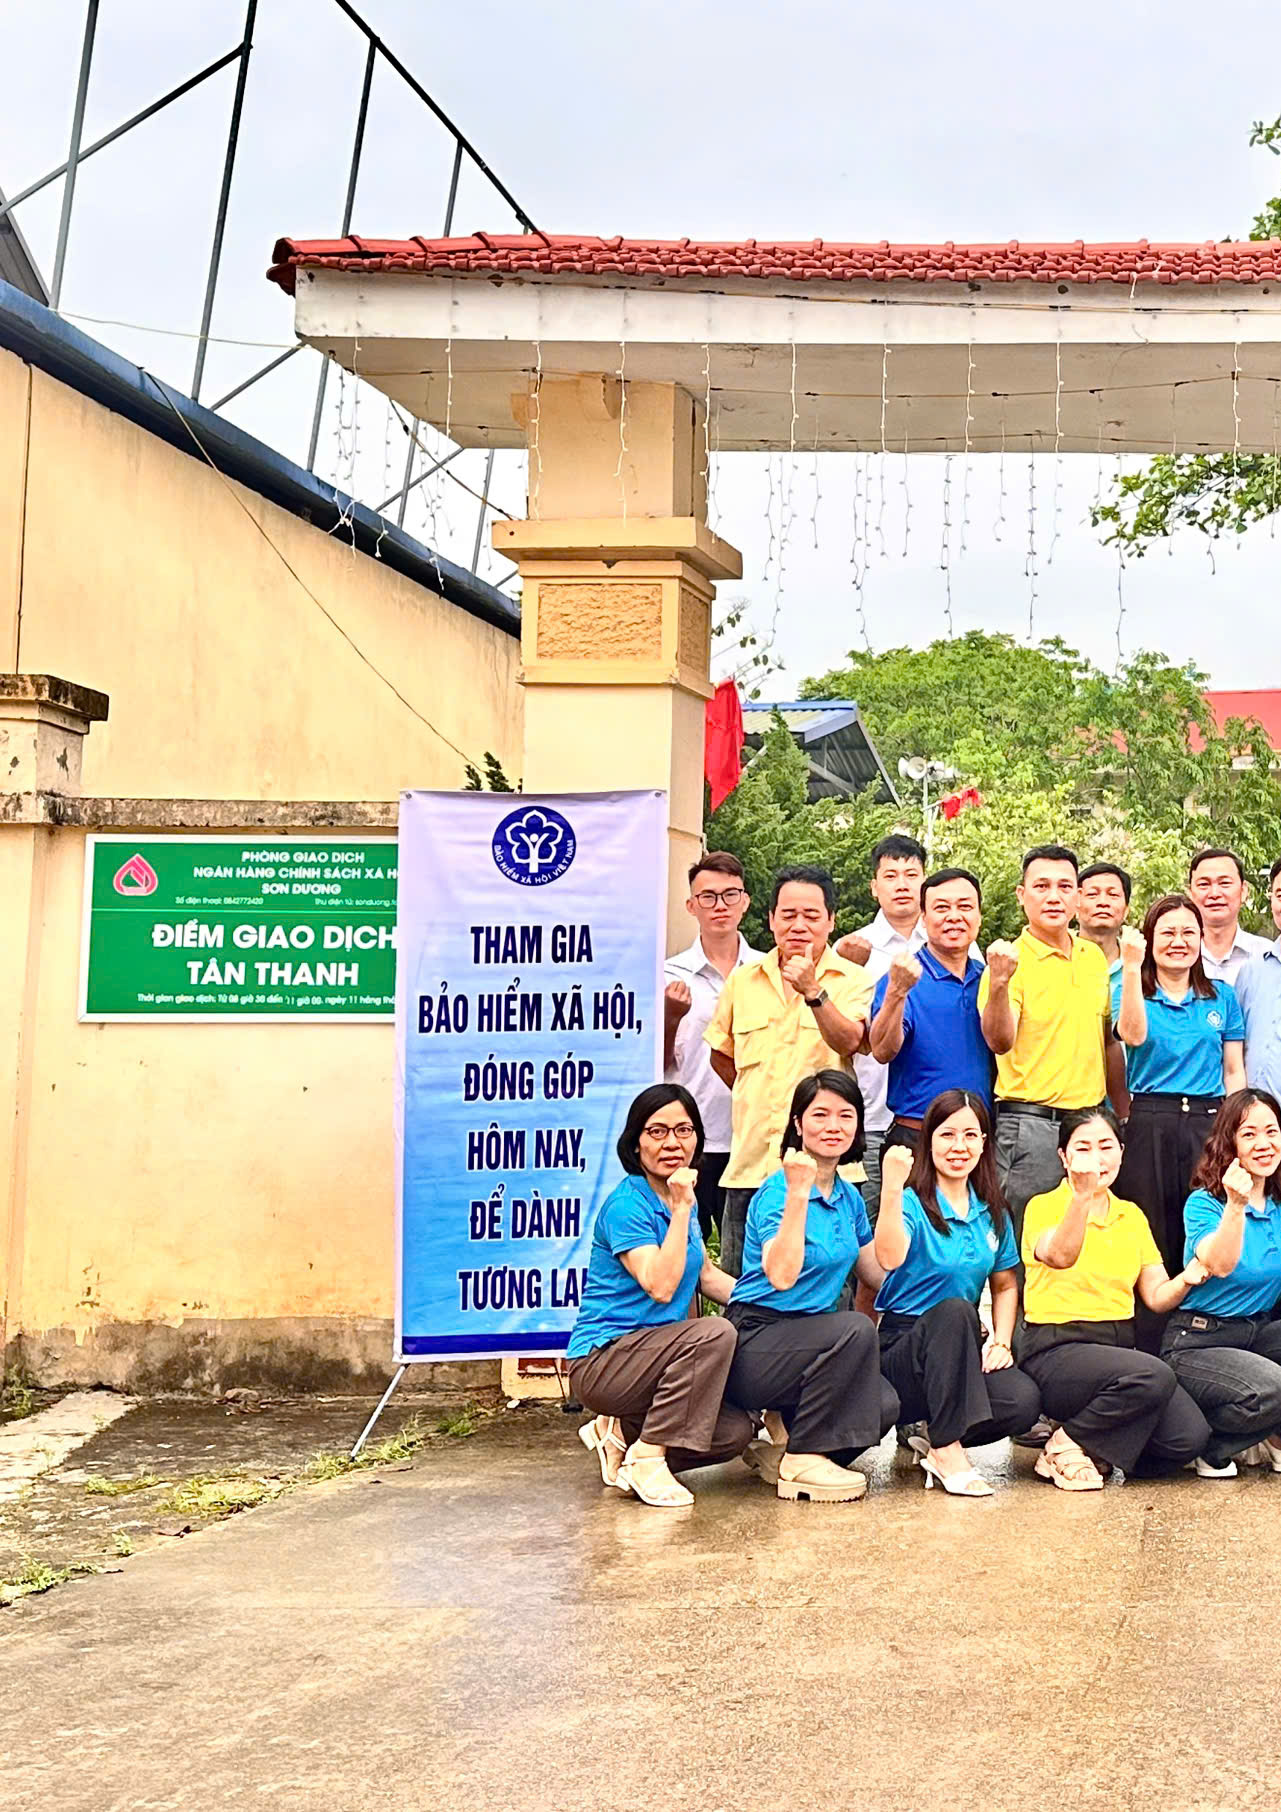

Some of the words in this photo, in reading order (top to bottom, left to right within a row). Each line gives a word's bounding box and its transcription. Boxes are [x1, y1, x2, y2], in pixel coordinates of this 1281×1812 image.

[242, 850, 291, 864] PHÒNG
[292, 851, 329, 864] GIAO
[565, 839, 574, 859] NAM
[193, 865, 233, 878] NGÂN
[235, 865, 276, 879] HÀNG
[278, 866, 321, 879] CHÍNH
[323, 867, 362, 879] SÁCH
[152, 918, 224, 948] ĐIỂM
[232, 925, 315, 949] GIAO
[323, 925, 397, 952] DỊCH
[470, 925, 543, 964] THAM
[551, 924, 593, 963] GIA
[187, 957, 246, 985] TÂN
[254, 962, 359, 986] THANH
[418, 980, 469, 1034] BẢO
[477, 977, 542, 1032] HIỂM
[550, 984, 585, 1031] XÃ
[593, 982, 643, 1039] HỘI,
[464, 1053, 534, 1101] ĐÓNG
[543, 1052, 594, 1099] GÓP
[467, 1122, 526, 1170] HÔM
[535, 1128, 586, 1173] NAY,
[470, 1183, 505, 1240] ĐỂ
[511, 1190, 581, 1239] DÀNH
[458, 1265, 542, 1311] TƯƠNG
